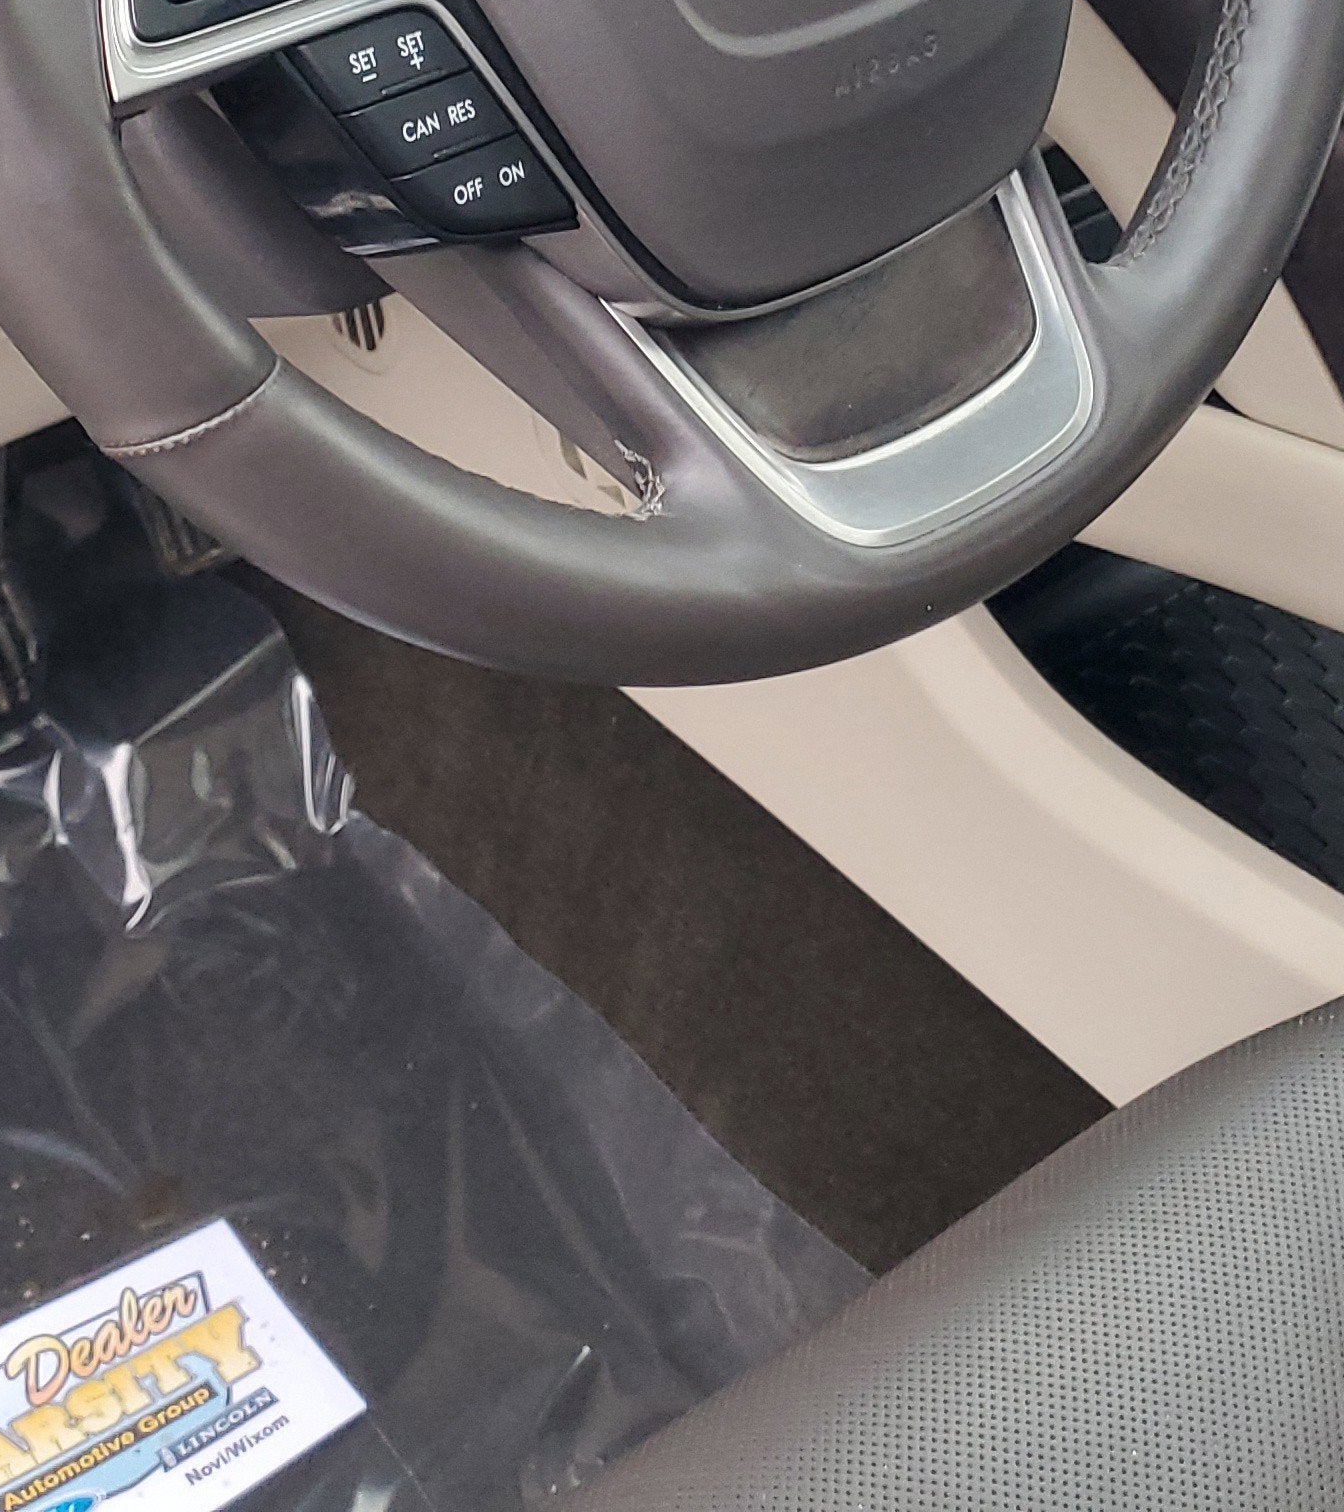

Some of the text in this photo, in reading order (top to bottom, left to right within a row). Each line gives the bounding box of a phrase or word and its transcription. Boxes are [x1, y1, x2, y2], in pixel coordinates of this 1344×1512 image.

[349, 47, 377, 75] SET
[397, 31, 424, 58] SET
[402, 99, 476, 143] CAN RES
[453, 161, 526, 206] OFF ON
[5, 1283, 198, 1406] Dealer
[4, 1387, 210, 1512] Automotive Group
[180, 1391, 272, 1456] LINCOLN
[184, 1414, 291, 1486] Novi/Wixom
